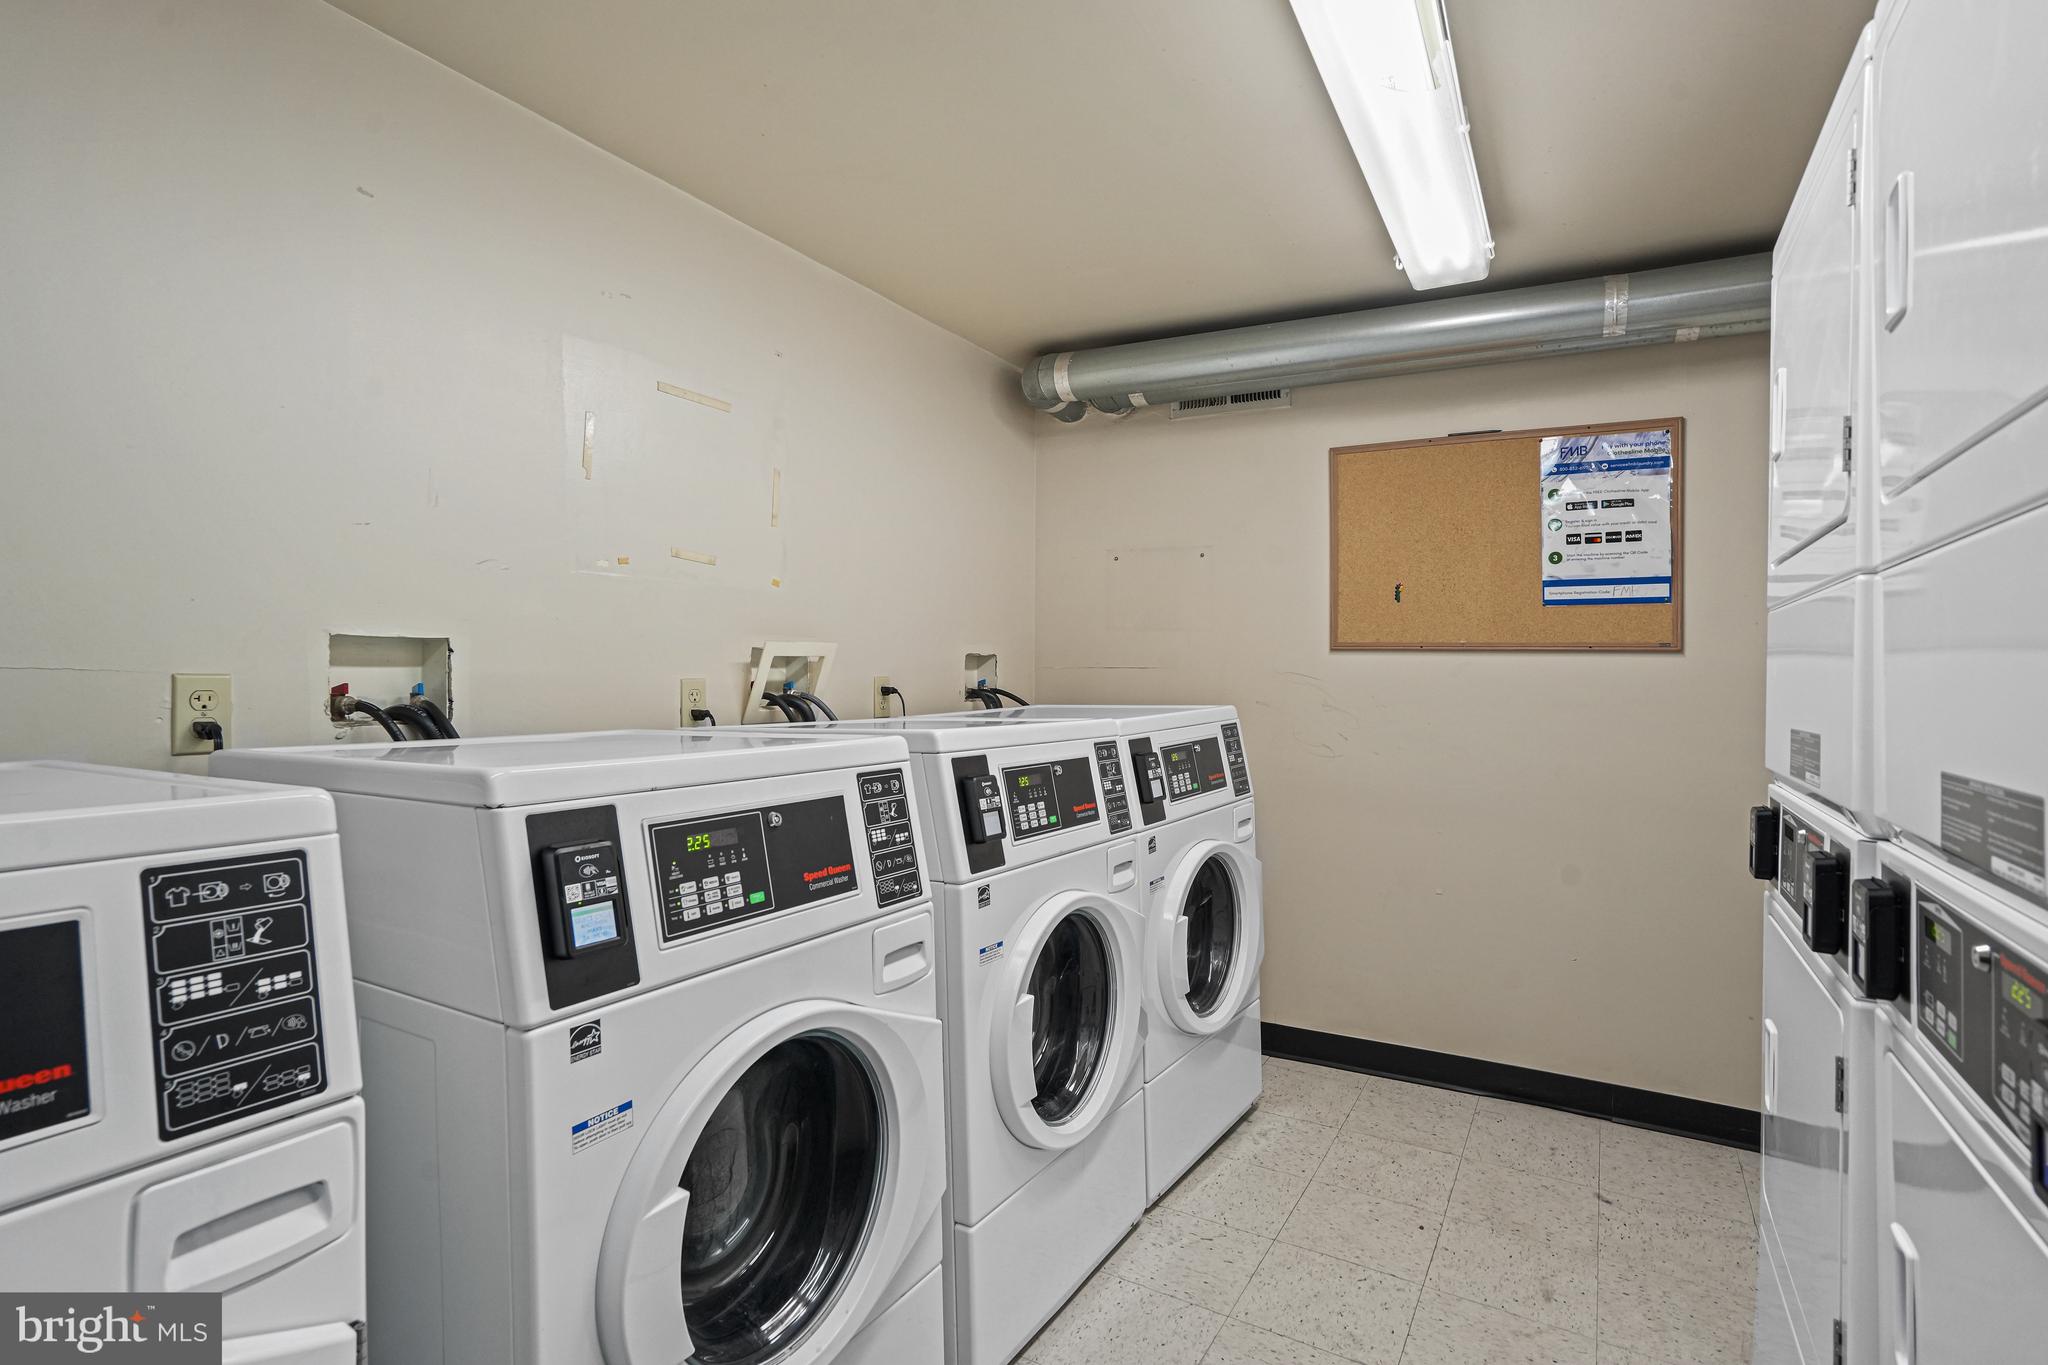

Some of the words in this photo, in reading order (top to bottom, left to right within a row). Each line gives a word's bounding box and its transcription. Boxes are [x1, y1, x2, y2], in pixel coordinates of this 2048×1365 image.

[1645, 440, 1667, 448] phone
[1560, 446, 1588, 460] FMB
[803, 867, 828, 882] Speed
[828, 863, 852, 875] Queen
[809, 878, 834, 891] Commercial
[834, 875, 849, 884] Washer
[571, 1051, 589, 1063] ENERGY
[590, 1047, 601, 1056] STAR
[0, 1064, 72, 1094] ueen
[587, 1107, 619, 1128] NOTICE
